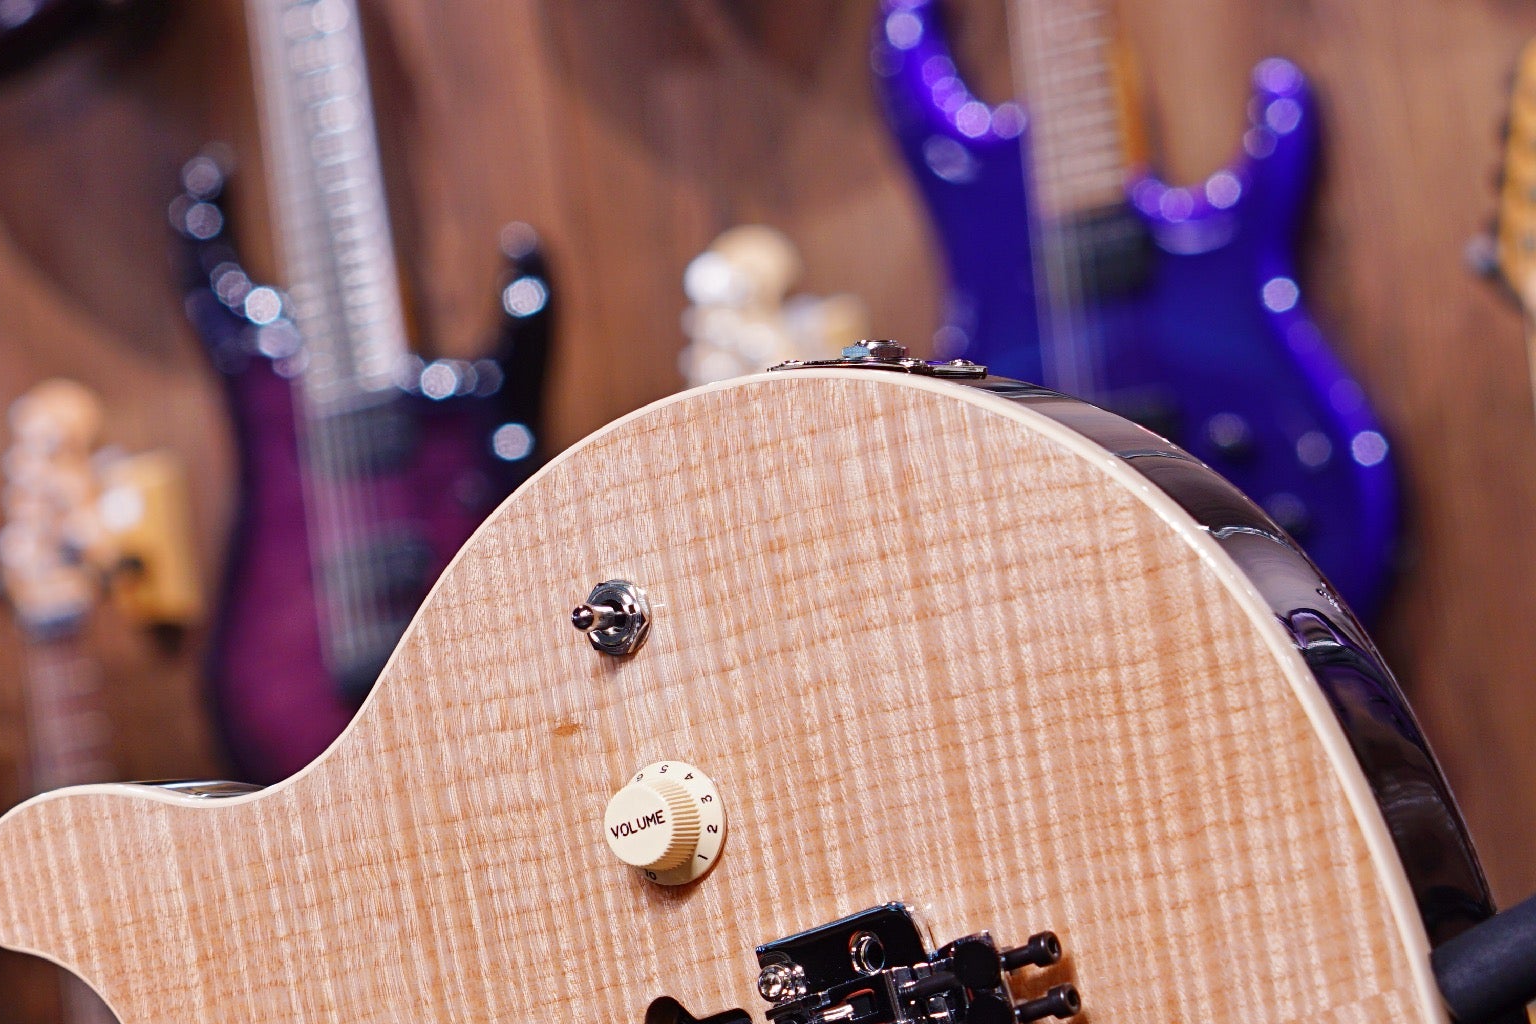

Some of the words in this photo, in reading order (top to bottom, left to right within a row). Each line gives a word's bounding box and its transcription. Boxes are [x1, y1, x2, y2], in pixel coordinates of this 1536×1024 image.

[700, 794, 713, 804] 3
[611, 809, 666, 839] VOLUME
[706, 824, 718, 834] 2
